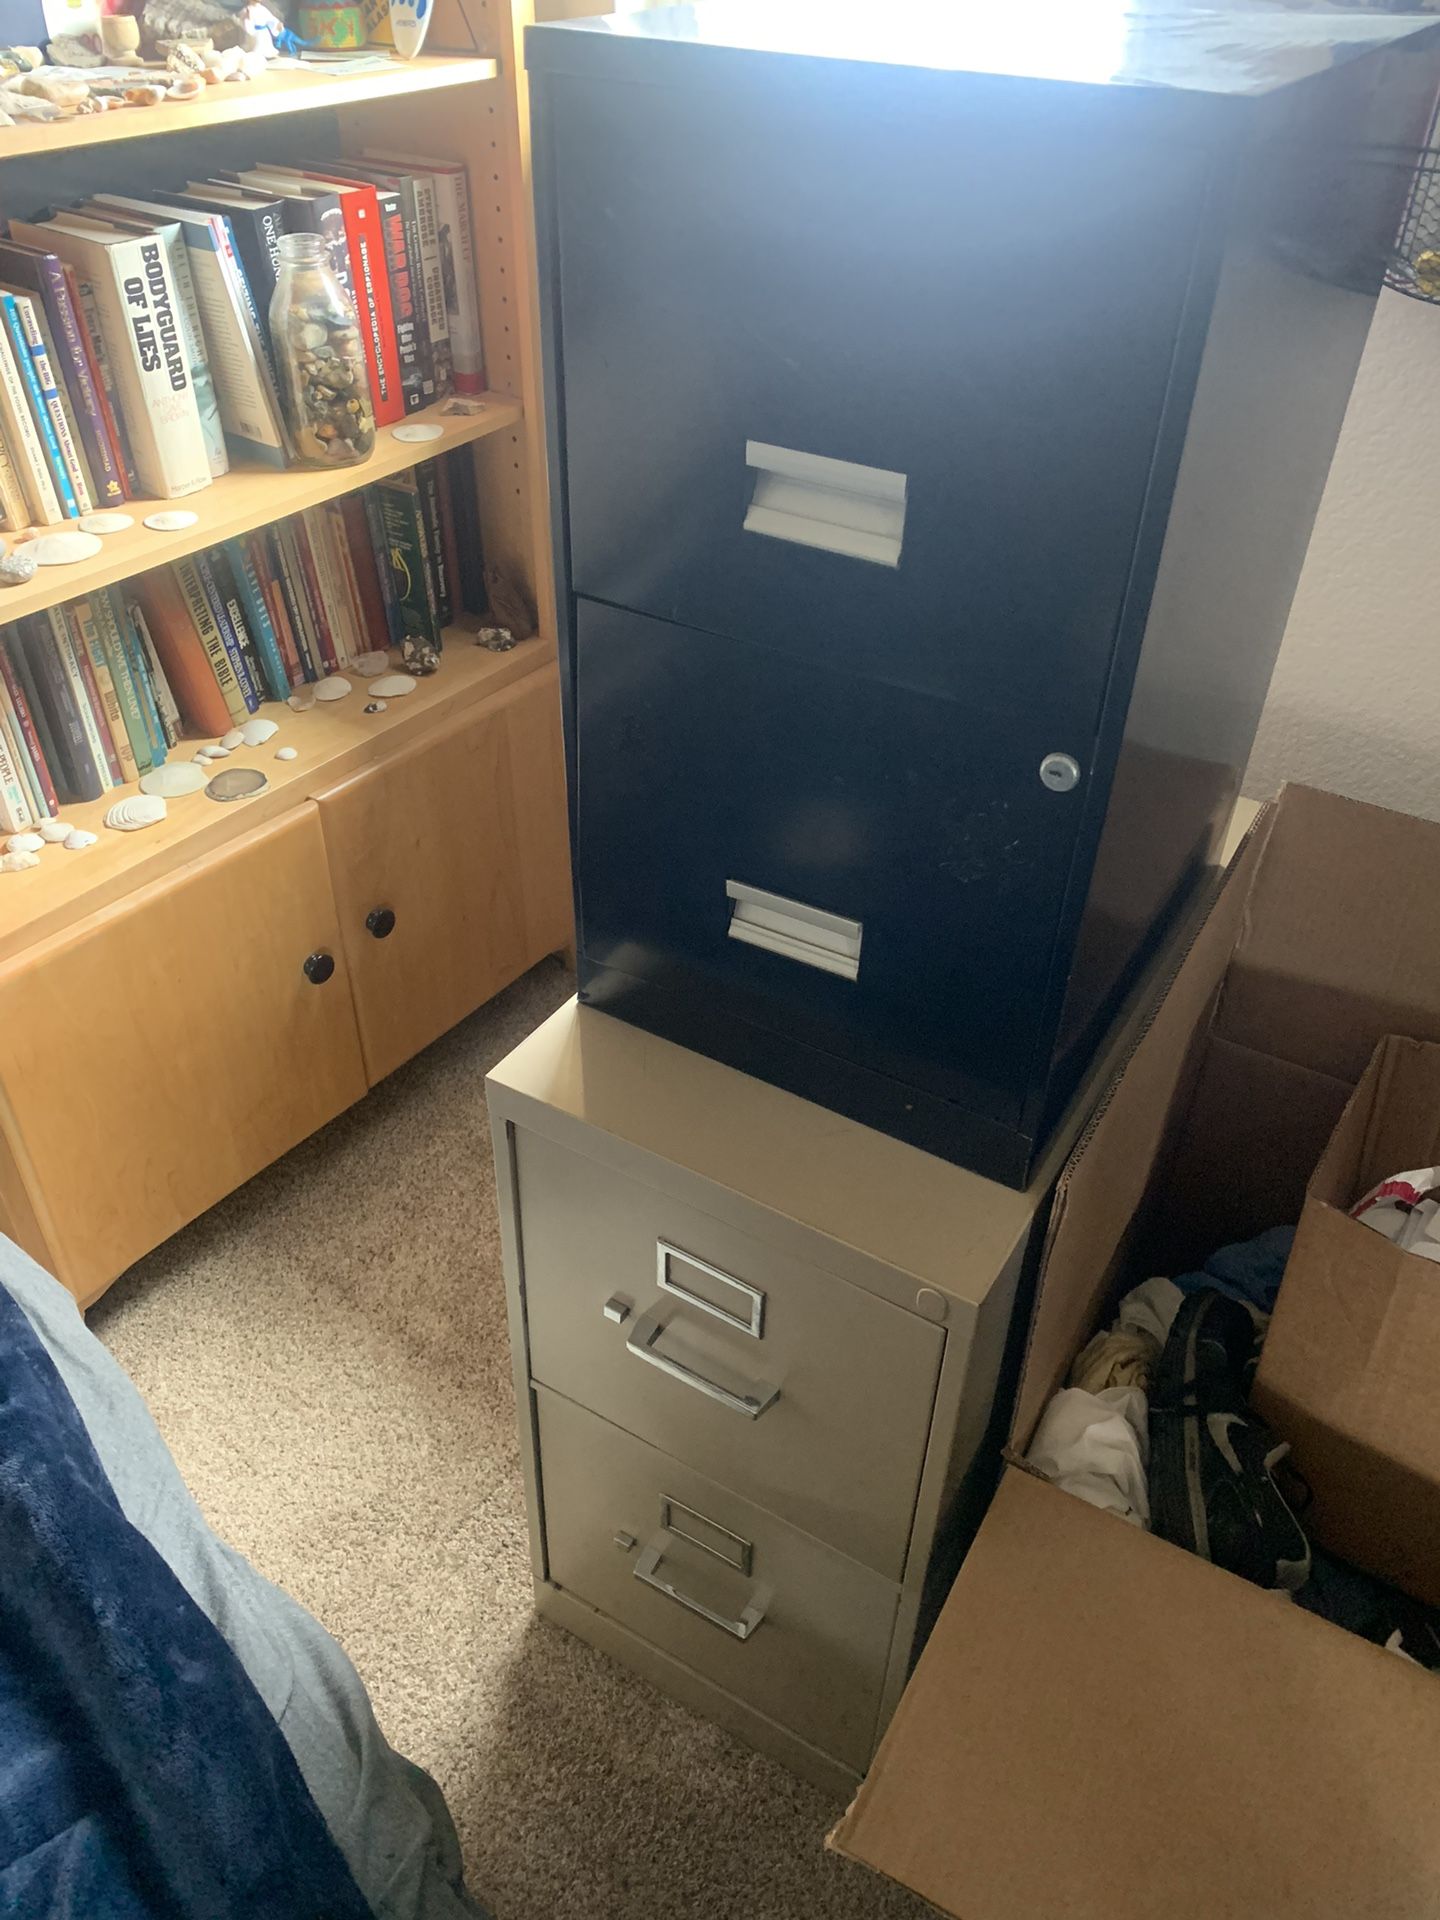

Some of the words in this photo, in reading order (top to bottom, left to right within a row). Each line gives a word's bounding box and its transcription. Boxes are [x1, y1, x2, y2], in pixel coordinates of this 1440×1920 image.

[262, 215, 277, 246] ONE
[415, 190, 428, 247] AMBROSE
[423, 187, 435, 237] STEPHEN
[389, 213, 407, 270] WAR
[48, 268, 64, 283] A
[269, 246, 281, 283] HUN
[360, 241, 373, 297] ESPIONAGE
[123, 275, 149, 310] OF
[367, 299, 376, 315] OF
[395, 271, 414, 318] DOG
[425, 276, 437, 325] COURAGE
[431, 266, 445, 330] UNDAUNTED
[22, 305, 40, 345] Unraveling
[55, 286, 78, 344] Passion
[141, 242, 188, 393] BODYGUARD
[71, 346, 85, 368] for
[132, 312, 162, 374] LIES
[371, 317, 384, 372] ENCYCLOPEDIA
[12, 320, 29, 359] Questions
[23, 357, 37, 384] people
[31, 383, 40, 395] ask
[48, 434, 57, 450] God
[39, 359, 48, 372] the
[43, 371, 53, 386] BIG
[77, 368, 97, 418] Victory
[13, 395, 23, 414] FOSSIL
[19, 414, 31, 438] RECORD
[50, 400, 68, 437] QUESTIONS
[63, 438, 75, 459] About
[69, 458, 79, 474] God
[82, 619, 96, 637] The
[179, 562, 214, 637] INTERPRETING
[206, 634, 219, 658] THE
[213, 657, 234, 688] BIBLE
[61, 632, 79, 679] INTIMACY
[104, 612, 121, 651] SHOULD
[119, 670, 133, 696] THEN
[103, 690, 121, 722] White
[0, 752, 15, 785] PEOPLE
[118, 743, 134, 763] IVP
